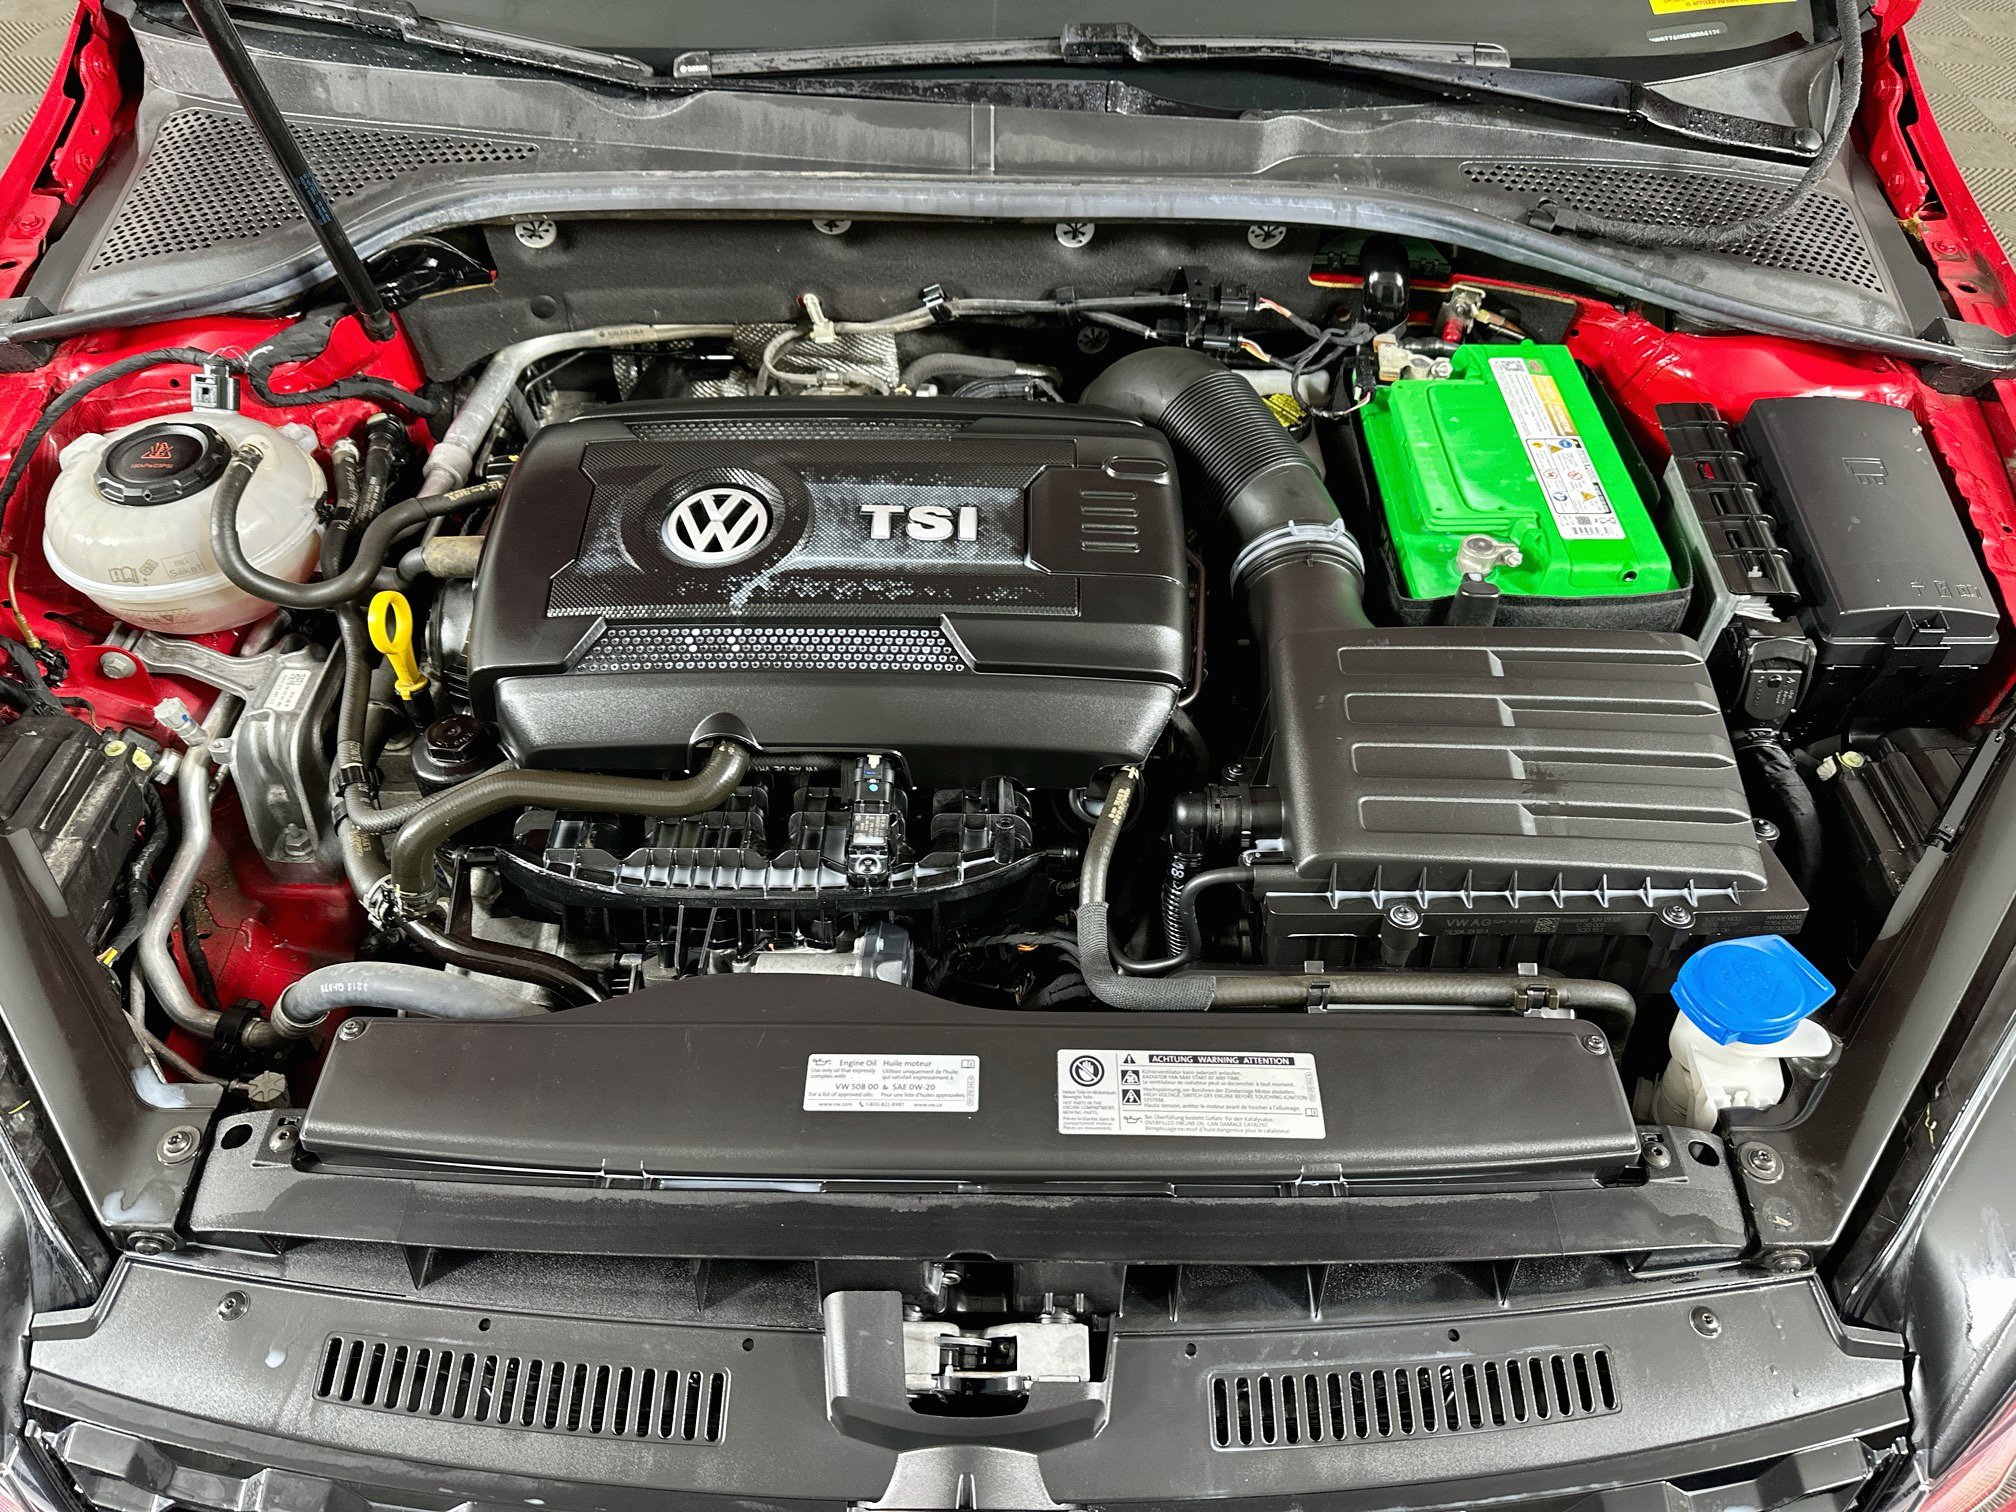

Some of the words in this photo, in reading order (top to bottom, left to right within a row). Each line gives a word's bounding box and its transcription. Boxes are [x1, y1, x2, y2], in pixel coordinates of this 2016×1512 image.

[664, 488, 768, 558] VW
[860, 505, 978, 540] TSI
[169, 565, 203, 577] Silikat
[1446, 918, 1469, 927] VW
[1470, 919, 1492, 927] AG
